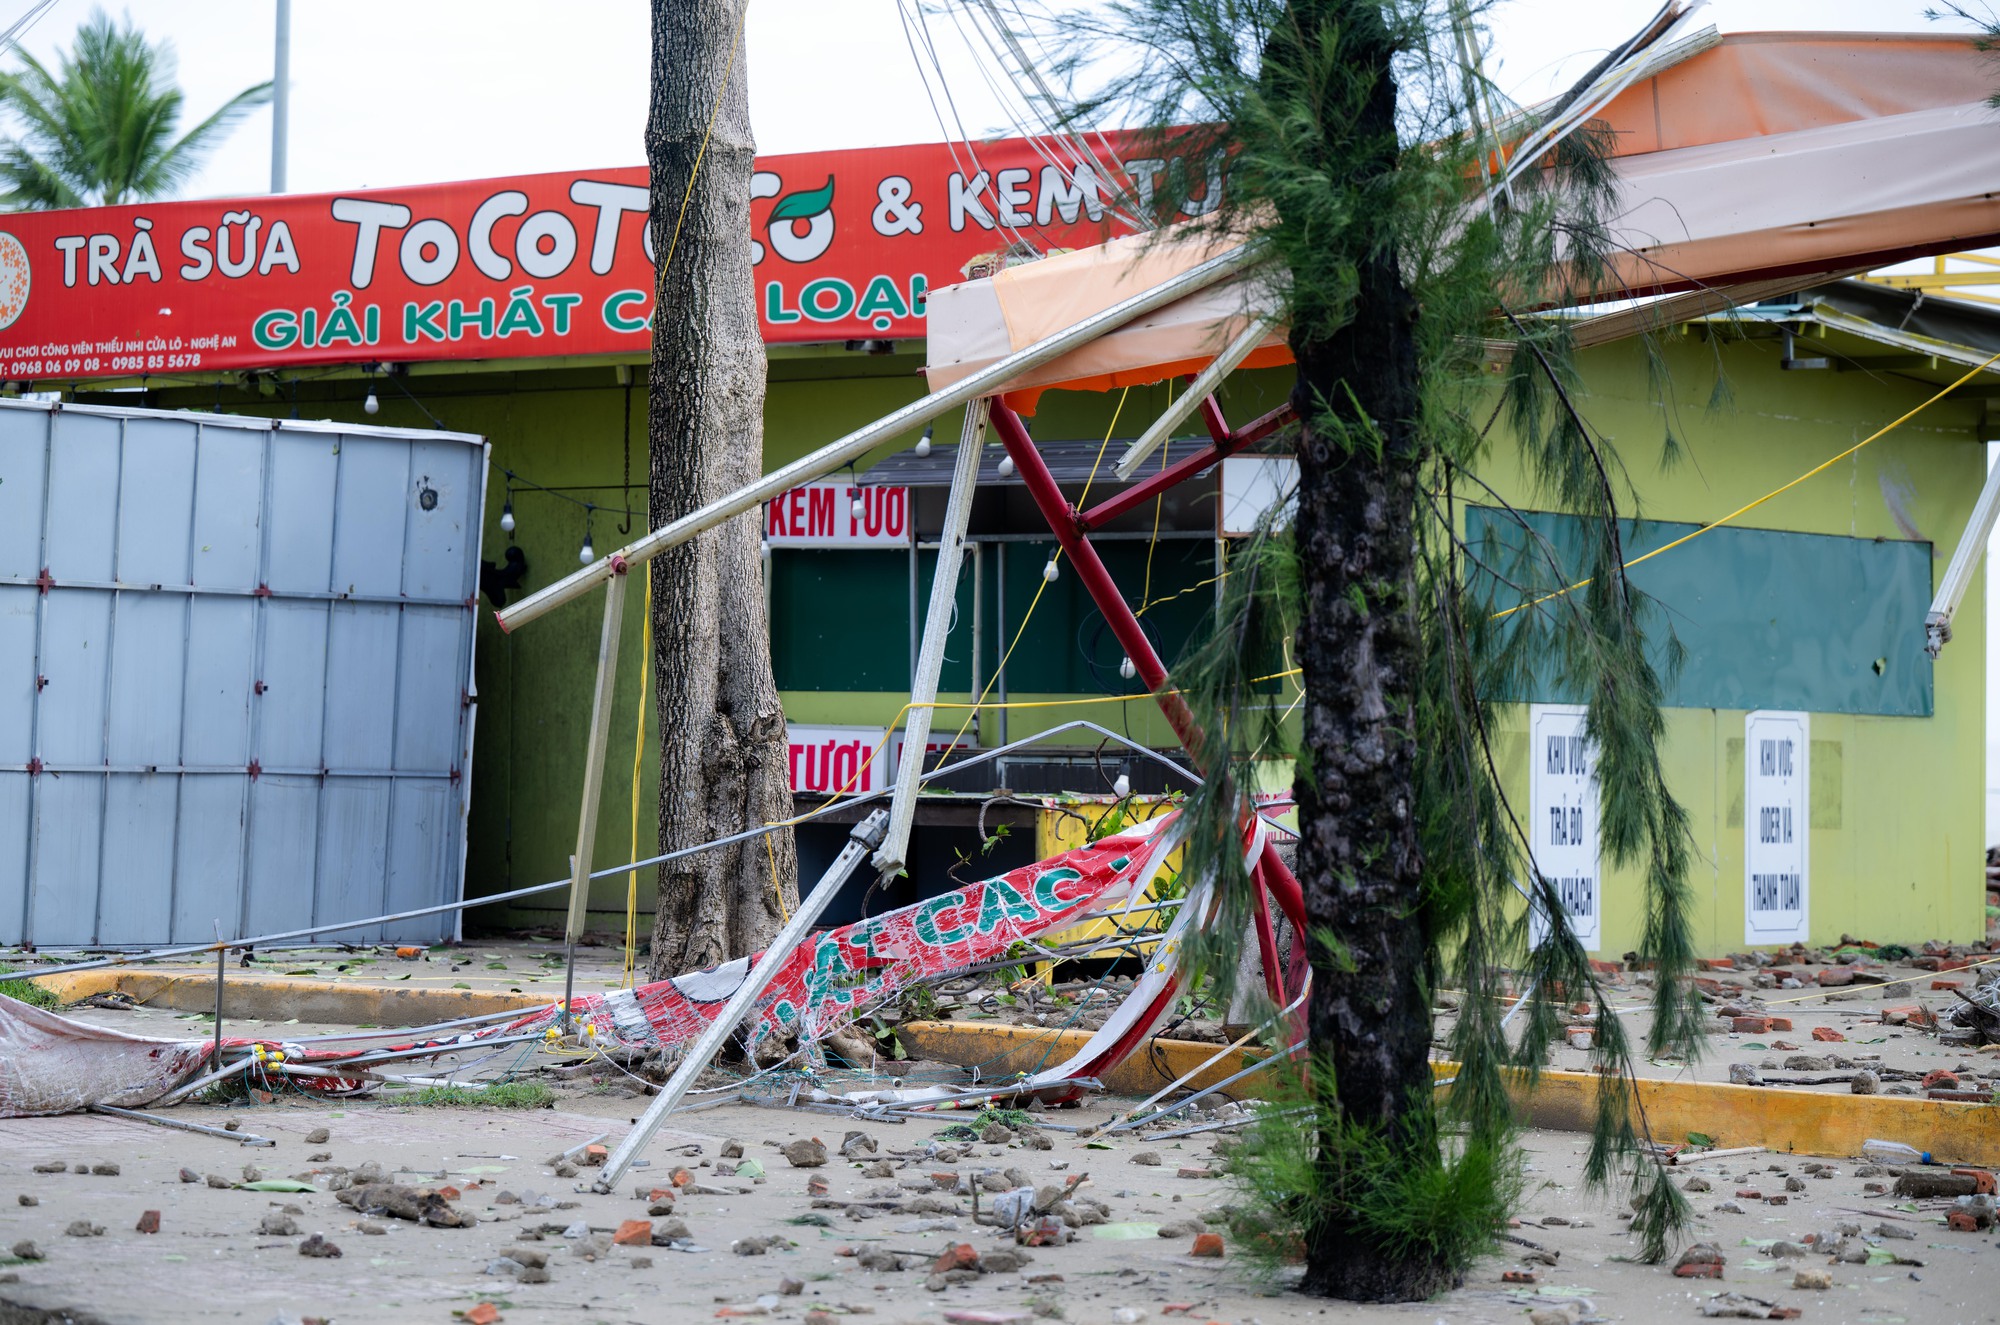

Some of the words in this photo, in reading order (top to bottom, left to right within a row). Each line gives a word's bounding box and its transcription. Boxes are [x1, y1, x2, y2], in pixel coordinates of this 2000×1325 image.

[54, 217, 162, 288] TRÀ
[180, 209, 300, 281] SỮA
[872, 174, 924, 237] &
[947, 162, 1104, 232] KEM
[252, 290, 380, 350] GIẢI
[403, 285, 583, 344] KHÁT
[765, 273, 927, 331] LOẠI
[11, 361, 42, 375] 0968
[45, 360, 61, 373] 06
[64, 358, 81, 373] 09
[84, 357, 100, 372] 08
[112, 356, 144, 370] 0985
[147, 354, 164, 369] 85
[167, 353, 201, 368] 5678
[41, 342, 69, 357] CÔNG
[71, 340, 93, 355] VIÊN
[95, 336, 124, 353] THIẾU
[125, 341, 144, 353] NHI
[169, 336, 182, 350] LÒ
[190, 333, 219, 351] NGHỆ
[221, 336, 237, 348] AN
[769, 487, 835, 537] KEM
[789, 739, 872, 793] TƯƠI
[1547, 736, 1566, 775] KHU
[1760, 739, 1776, 776] KHU
[1760, 806, 1780, 844] ODER
[1561, 868, 1592, 916] KHÁCH
[1752, 874, 1778, 911] THANH
[1780, 866, 1800, 911] TOÁN
